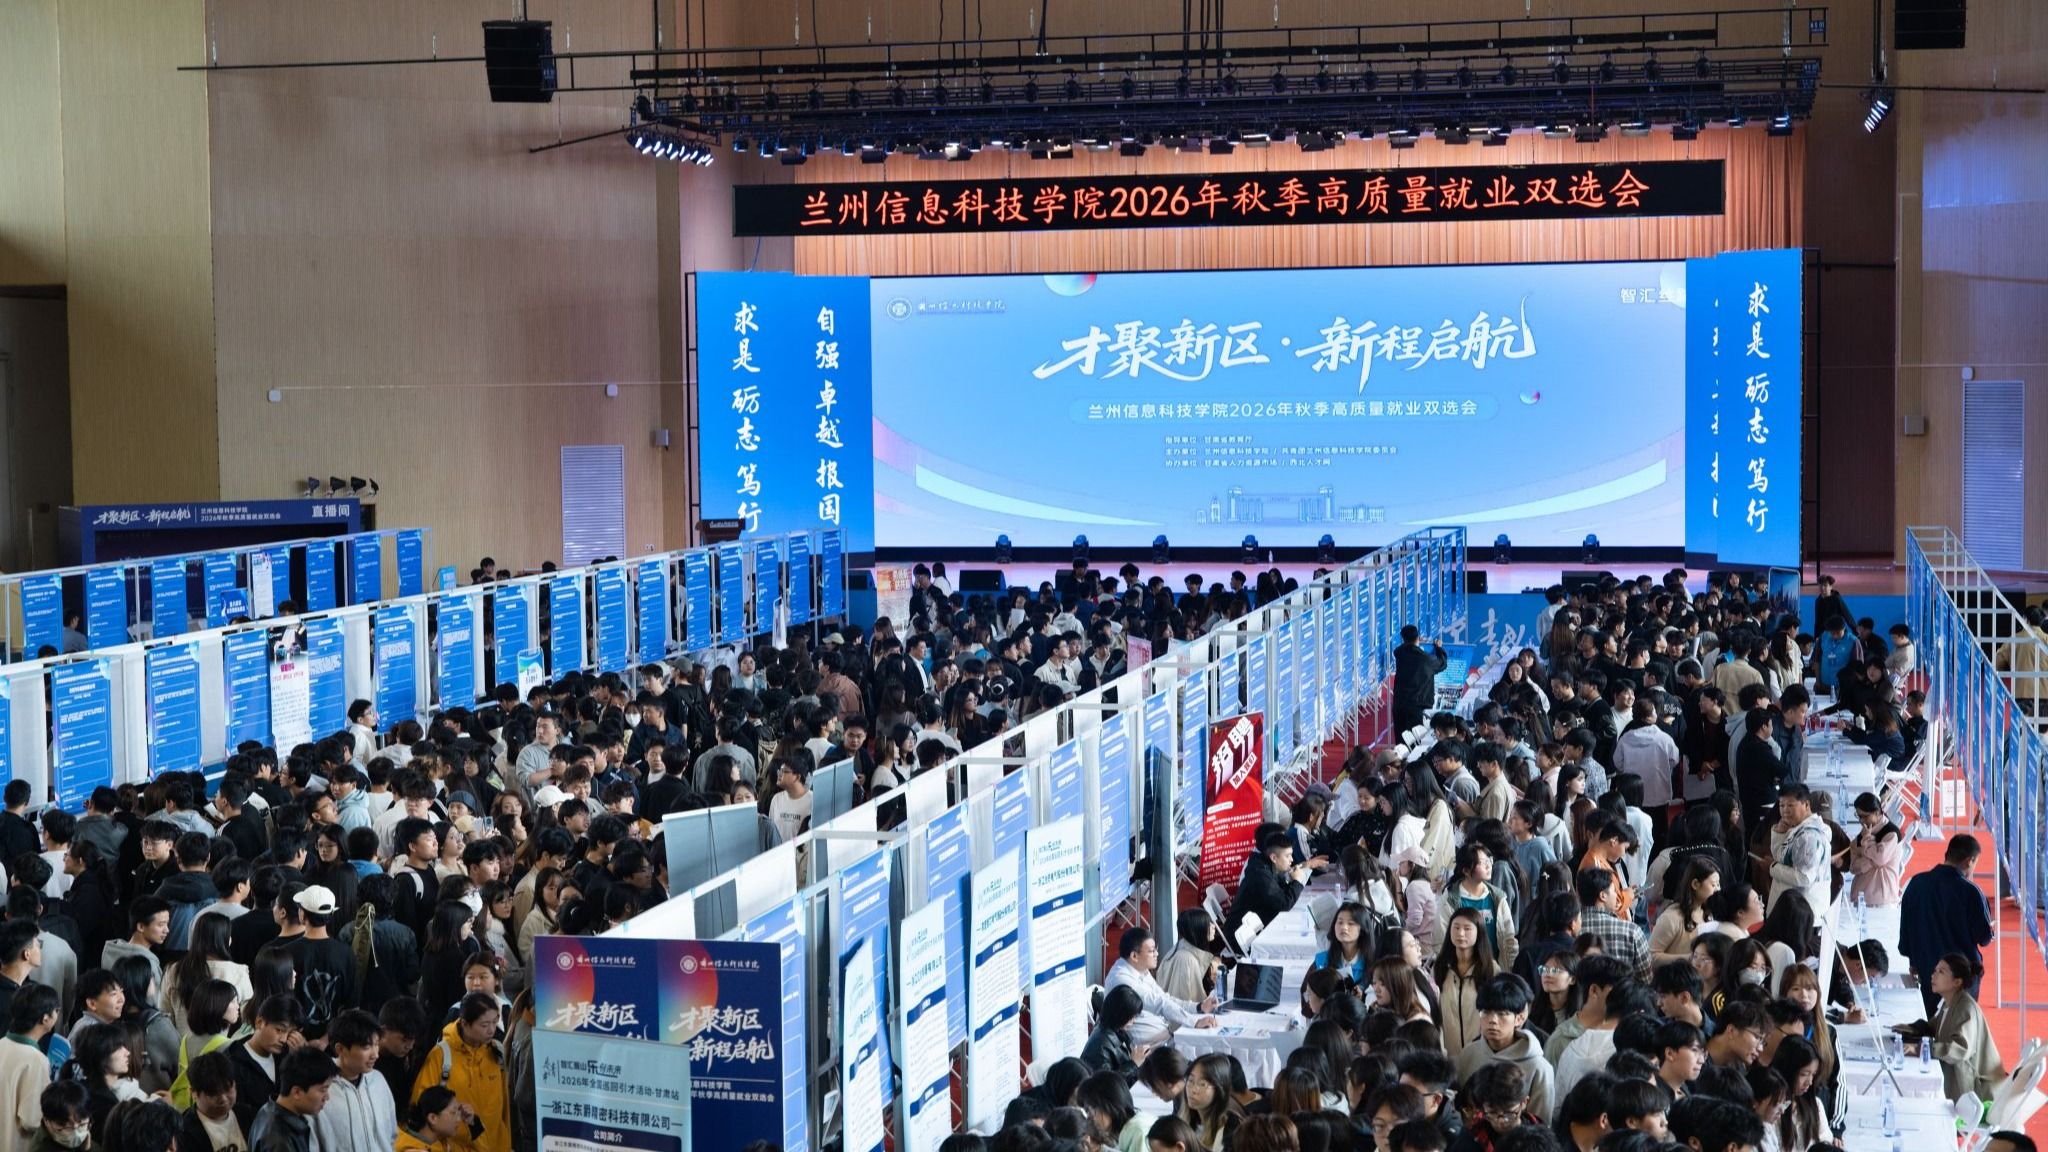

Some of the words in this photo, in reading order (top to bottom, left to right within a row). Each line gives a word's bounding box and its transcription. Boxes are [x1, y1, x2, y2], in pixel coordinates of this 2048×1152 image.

[800, 168, 1650, 227] 兰州信息科技学院2026年秋季高质量就业双选会
[1088, 400, 1477, 419] 兰州信息科技学院2026年秋季高质量就业双选会
[312, 504, 350, 517] 直播间
[545, 1000, 639, 1031] 才聚新区
[668, 1005, 763, 1036] 才聚新区
[690, 1029, 775, 1073] 新程启航
[691, 1080, 731, 1090] 息科技学院
